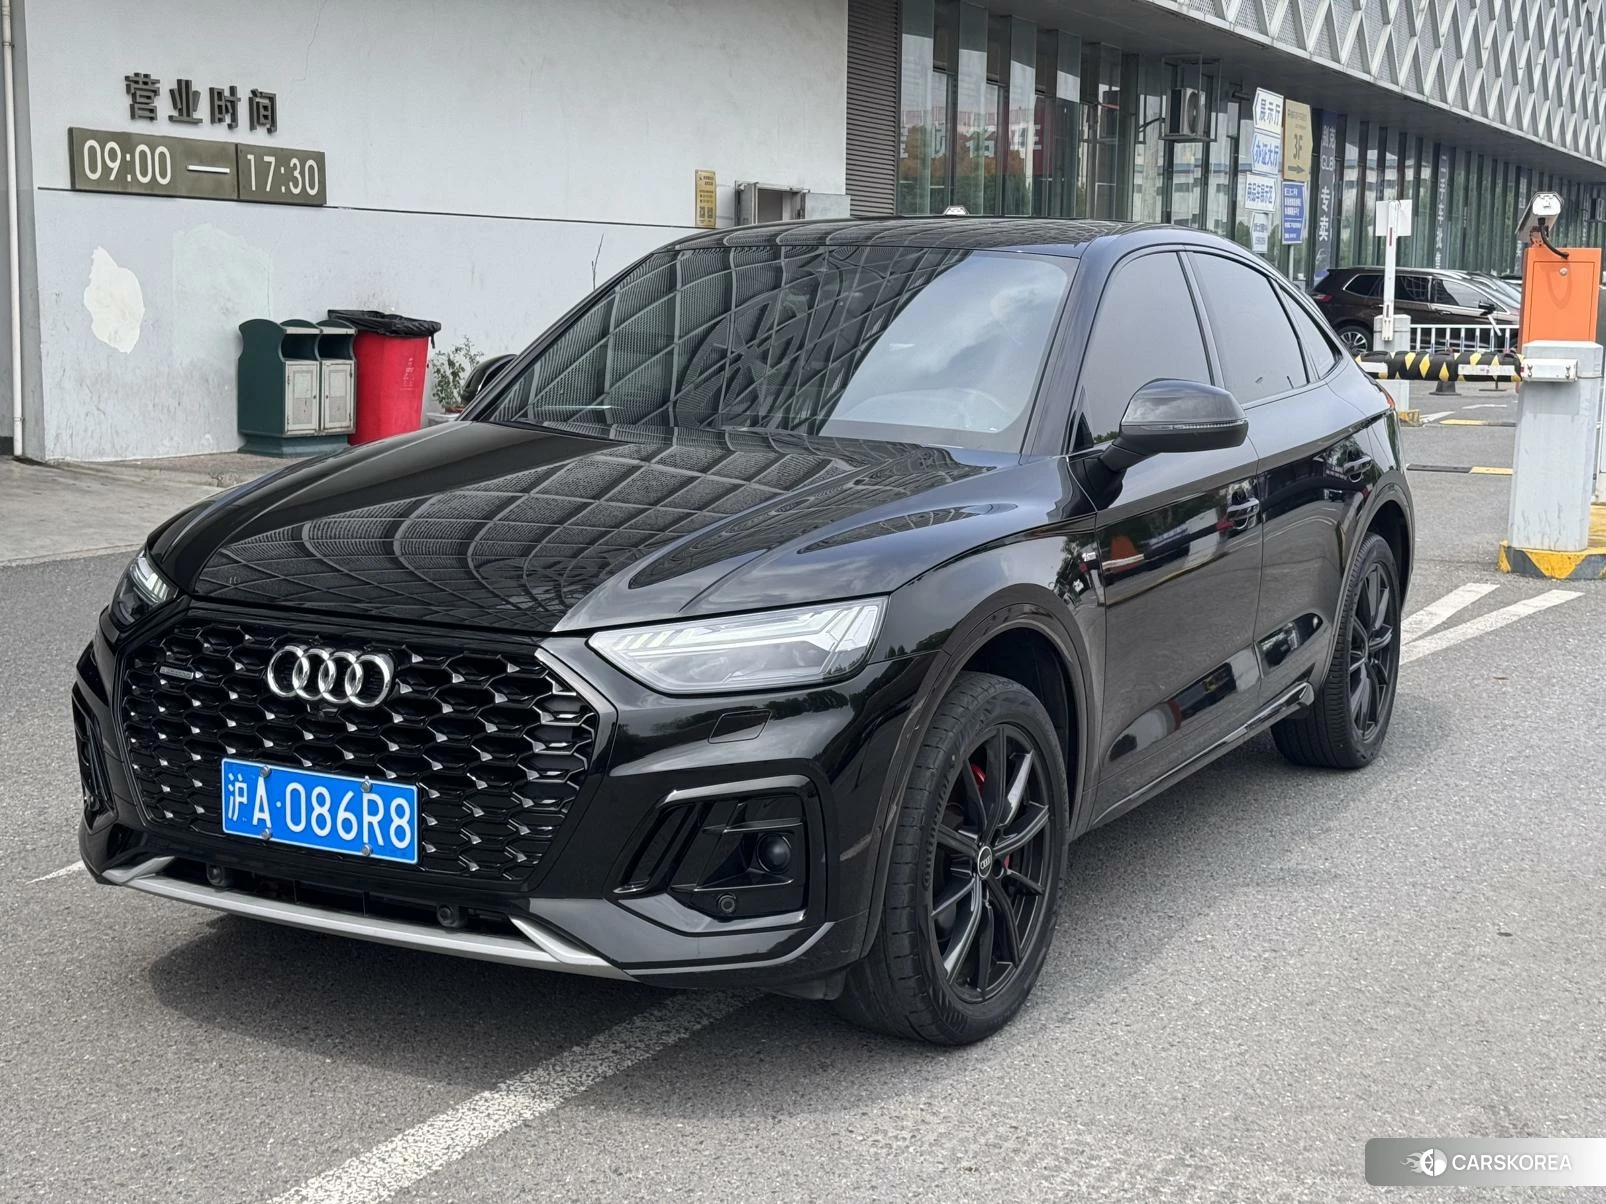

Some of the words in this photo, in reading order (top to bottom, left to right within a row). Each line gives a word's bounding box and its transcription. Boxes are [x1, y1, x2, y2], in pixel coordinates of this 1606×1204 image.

[124, 72, 278, 134] 营业时间
[1259, 99, 1281, 126] 展示厅
[83, 139, 171, 185] 09:00
[247, 154, 318, 196] 17:30
[1254, 140, 1280, 169] 办证大厅
[1293, 133, 1303, 161] 3F
[1319, 186, 1330, 242] 专卖
